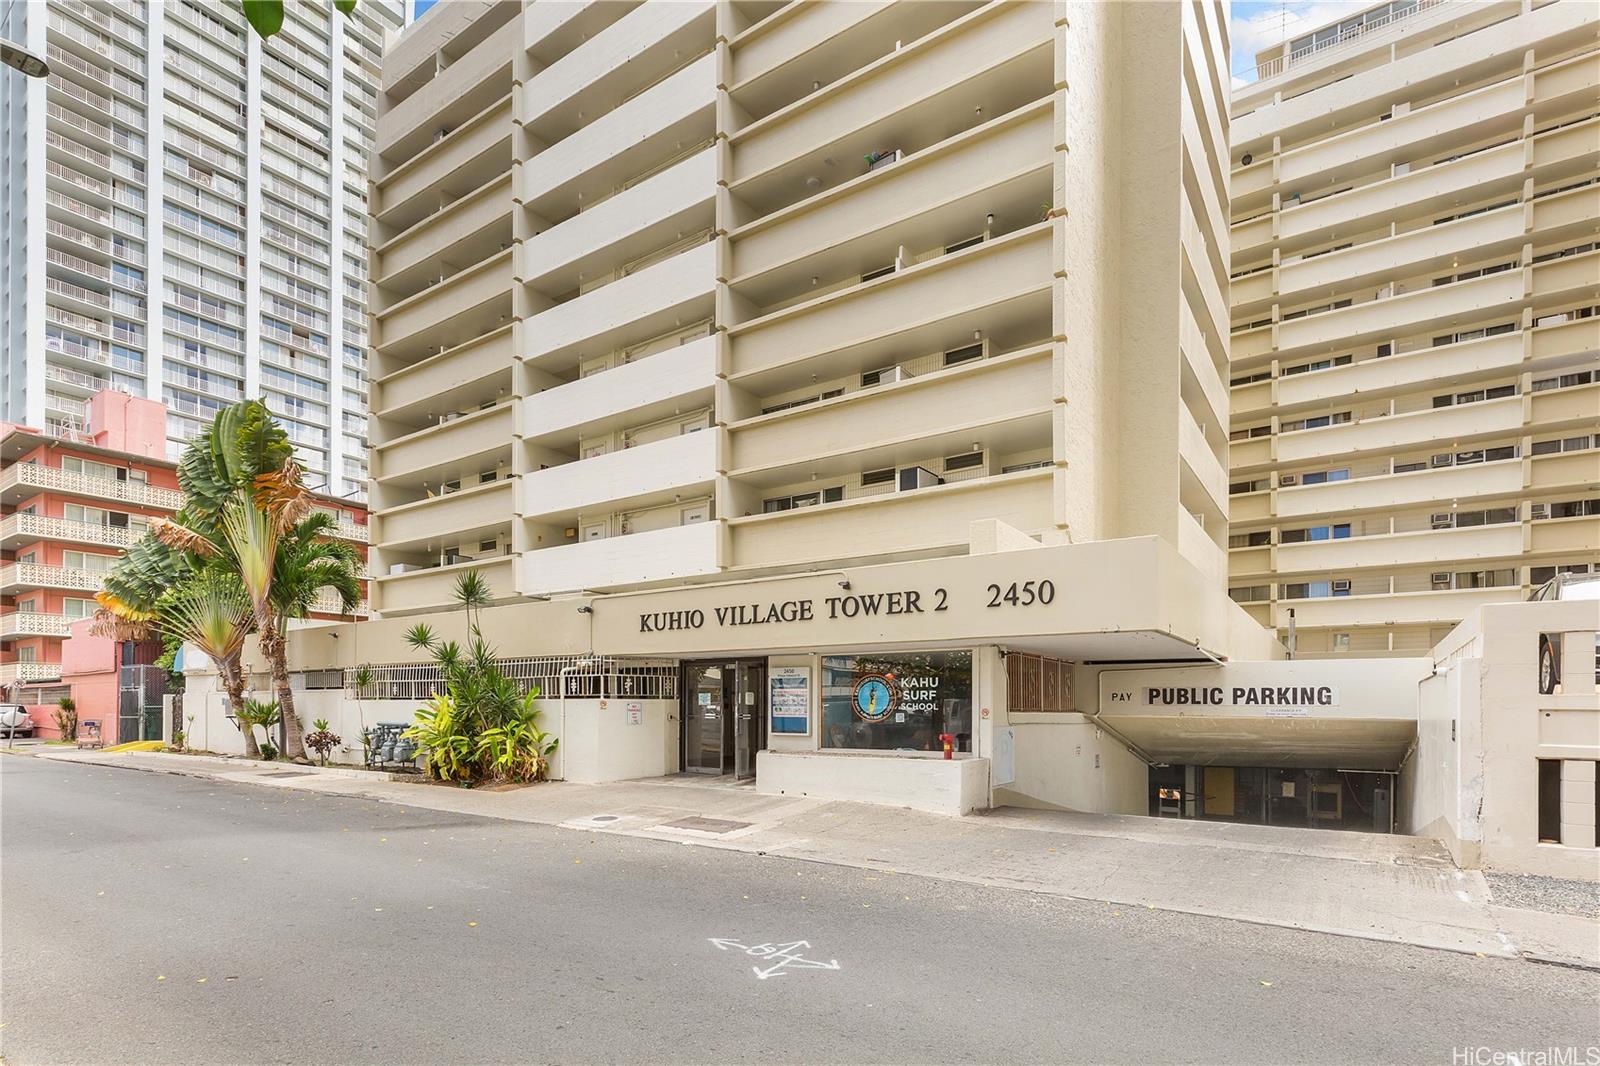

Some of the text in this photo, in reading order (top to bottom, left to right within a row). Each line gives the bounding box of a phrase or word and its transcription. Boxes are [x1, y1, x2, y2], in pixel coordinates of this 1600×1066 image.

[640, 579, 1055, 632] KUHIO VILLAGE TOWER 2 2450
[901, 677, 939, 688] KAHU
[903, 690, 937, 700] SURF
[1111, 686, 1332, 705] PAY PUBLIC PARKING
[900, 702, 939, 711] SCHOOL
